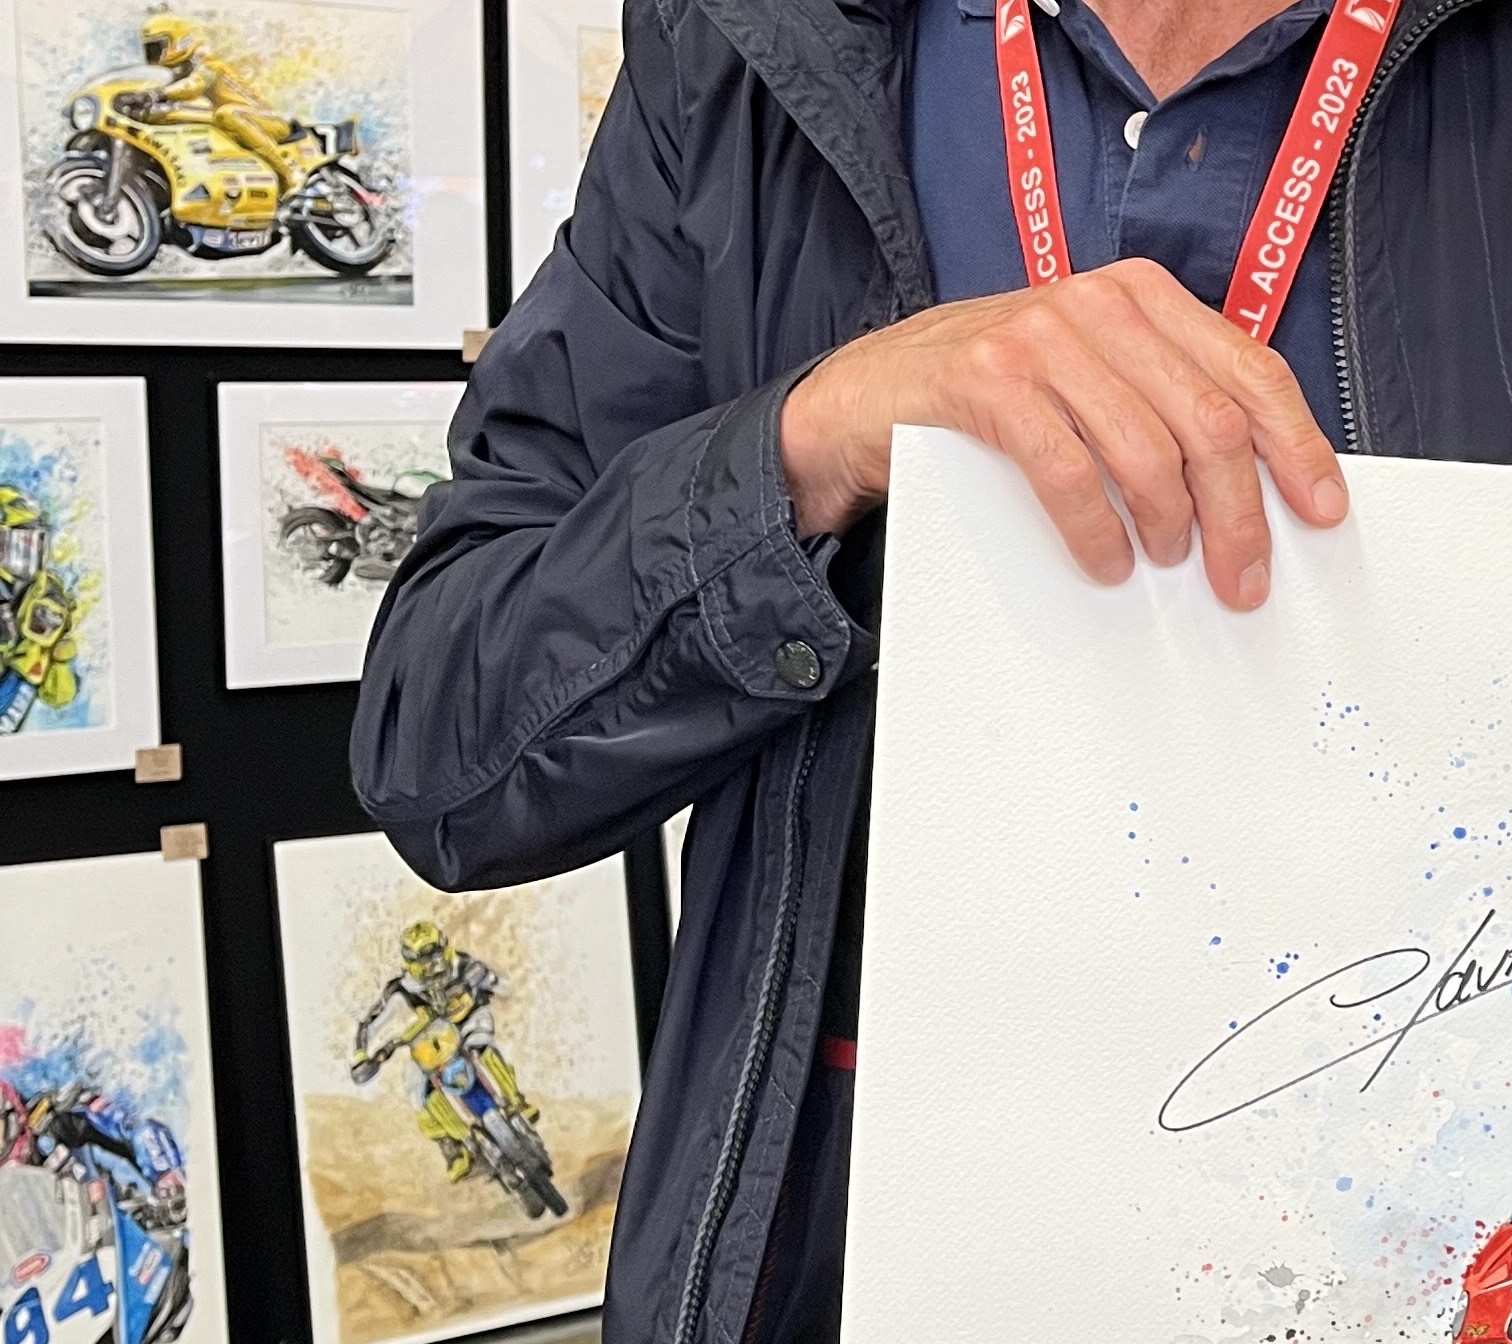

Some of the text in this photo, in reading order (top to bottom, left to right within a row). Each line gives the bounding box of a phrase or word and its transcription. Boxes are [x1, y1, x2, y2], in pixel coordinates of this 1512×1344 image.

[1010, 70, 1038, 143] 2023
[1020, 165, 1059, 283] CCESS
[1250, 155, 1321, 295] ACCESS
[1311, 57, 1359, 134] 2023
